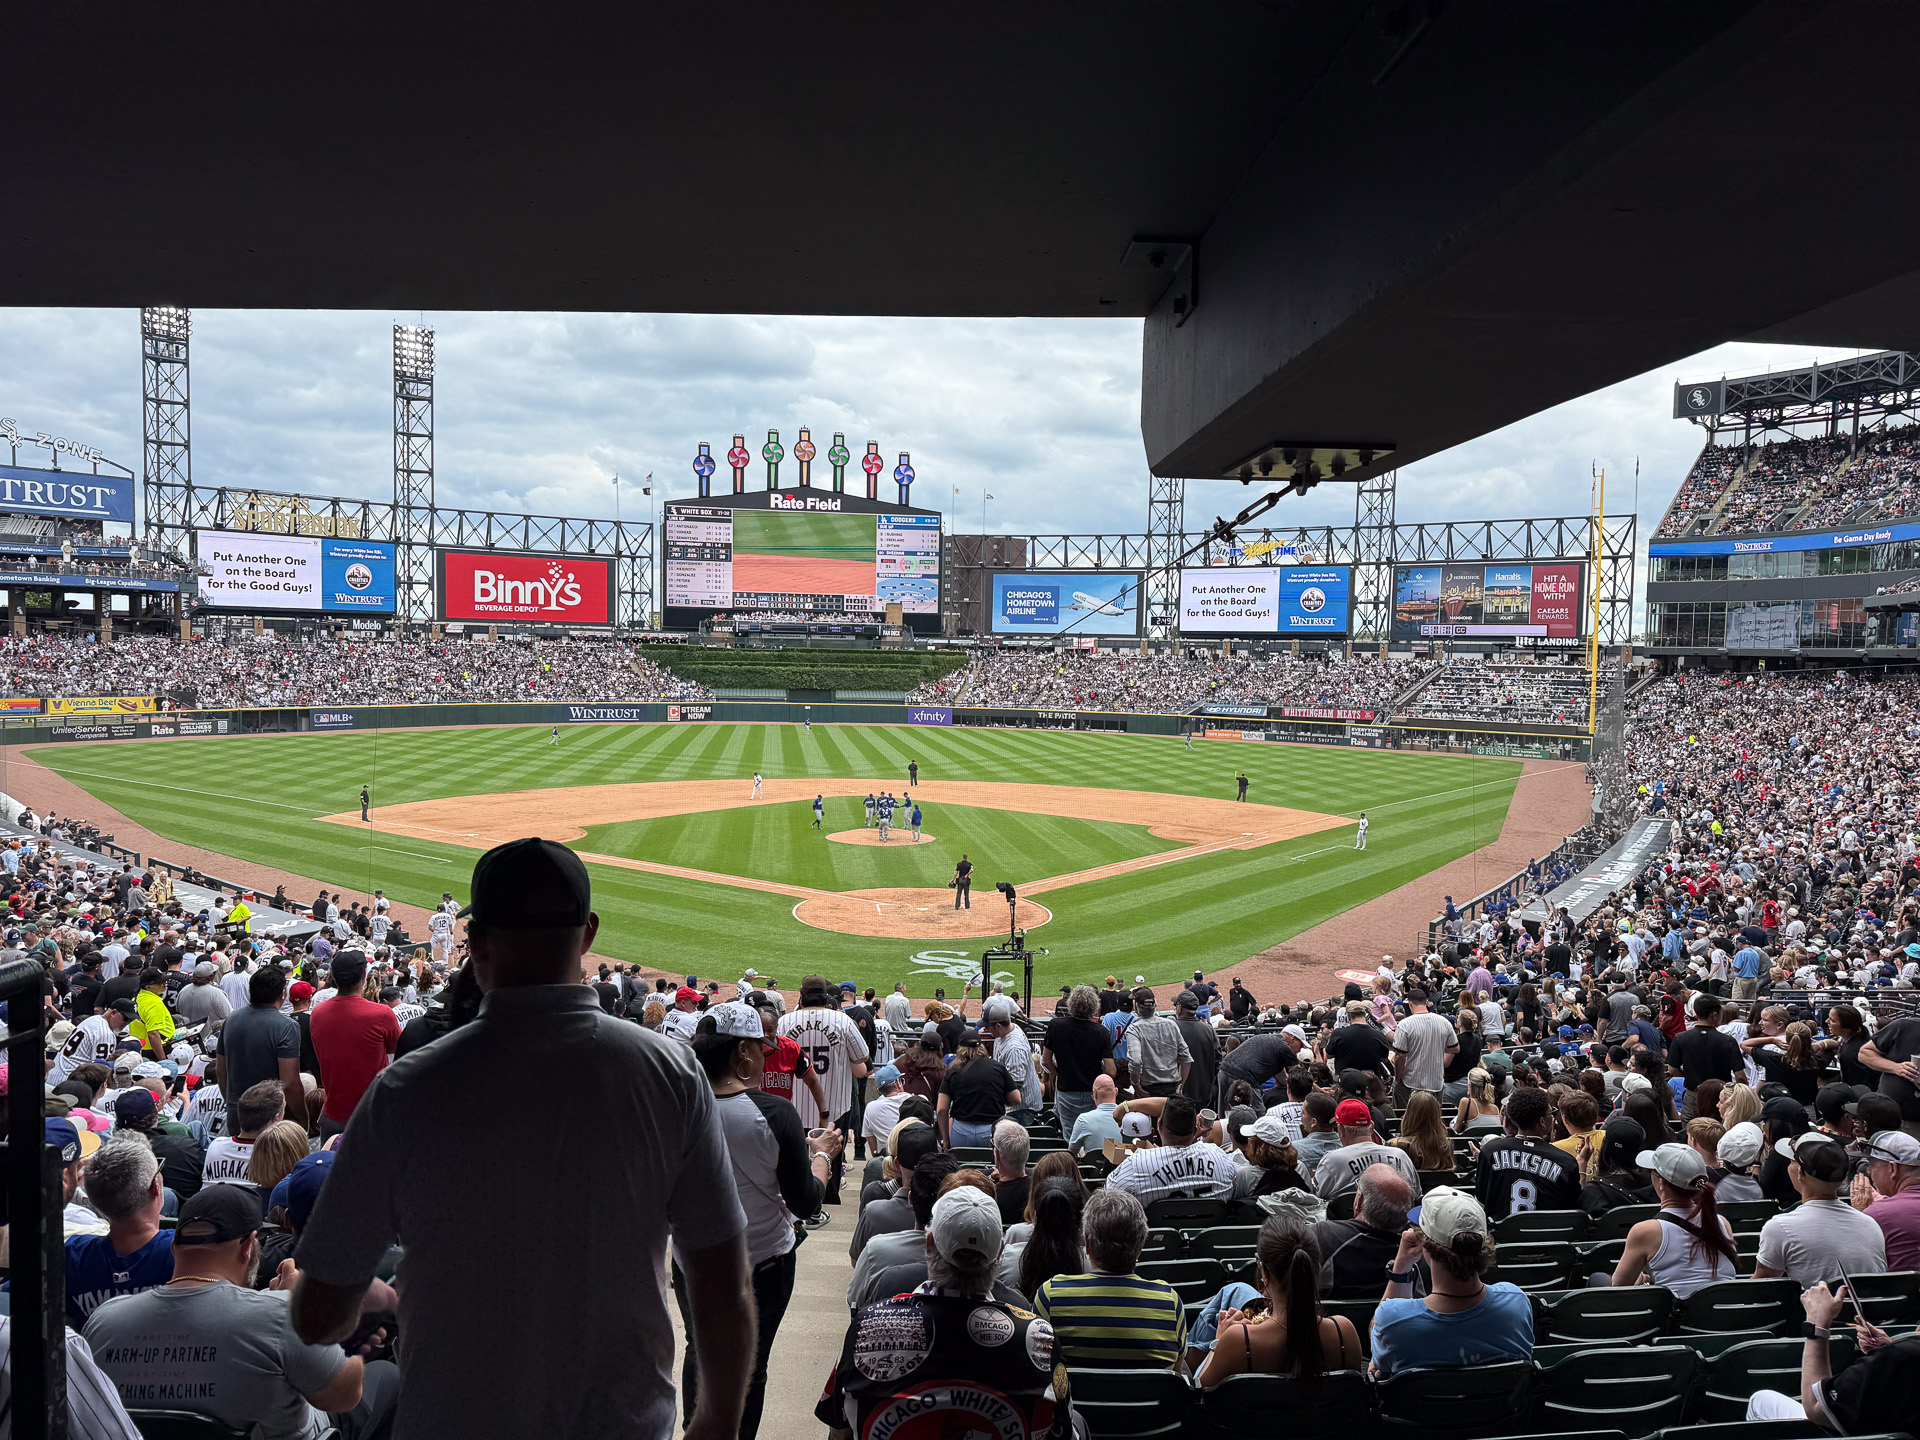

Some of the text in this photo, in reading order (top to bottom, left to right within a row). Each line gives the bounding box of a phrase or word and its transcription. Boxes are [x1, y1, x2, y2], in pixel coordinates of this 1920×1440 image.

[35, 432, 102, 464] ZONE
[233, 492, 311, 510] CAESARS
[770, 494, 841, 511] Rate Field
[233, 509, 360, 538] SPORTSBOOK
[1834, 530, 1892, 544] Be Game Day Ready
[1241, 540, 1287, 560] Miller
[1275, 546, 1296, 556] TIME
[1734, 542, 1774, 551] WINTRUST
[213, 552, 307, 566] Put Another One
[225, 567, 296, 579] on the Board
[33, 575, 61, 584] Banking
[1543, 575, 1558, 583] HIT
[207, 579, 313, 595] for the Good Guys!
[1192, 585, 1267, 594] Put Another One
[1534, 582, 1575, 593] HOME RUN
[334, 593, 384, 604] WINTRUST
[1006, 591, 1052, 599] CHICAGO'S
[1543, 592, 1566, 600] WITH
[1006, 599, 1055, 608] HOMETOWN
[1213, 597, 1228, 606] the
[1230, 597, 1257, 606] Board
[474, 604, 540, 613] BEVERAGE DEPOT
[1006, 607, 1037, 615] AIRLINE
[1187, 608, 1270, 619] for the Good Guys!
[352, 619, 382, 630] Modelo
[1289, 616, 1337, 625] WINTRUST
[1515, 636, 1579, 648] Lite LANDING
[66, 698, 117, 707] Vienna Beef
[569, 706, 640, 721] WINTRUST
[913, 710, 946, 722] xfinity
[1055, 712, 1077, 720] PATIO
[1221, 706, 1262, 715] HYUNDAI
[1283, 708, 1334, 718] WHITTINGHAM
[1336, 709, 1361, 719] MEATS
[329, 714, 354, 722] MLB+
[52, 725, 108, 735] UnitedService
[151, 725, 175, 735] Rate
[1351, 737, 1368, 747] Rate
[1485, 747, 1509, 756] RUSH
[1491, 1150, 1563, 1183] JACKSON
[1152, 1158, 1215, 1187] THOMAS
[1510, 1179, 1538, 1212] 8
[105, 1346, 217, 1364] WARM-UP PARTNER
[868, 1356, 905, 1365] 19 83
[856, 1353, 924, 1380] WHITE SOX
[159, 1382, 216, 1399] MACHINE
[950, 1390, 1006, 1422] WHITE
